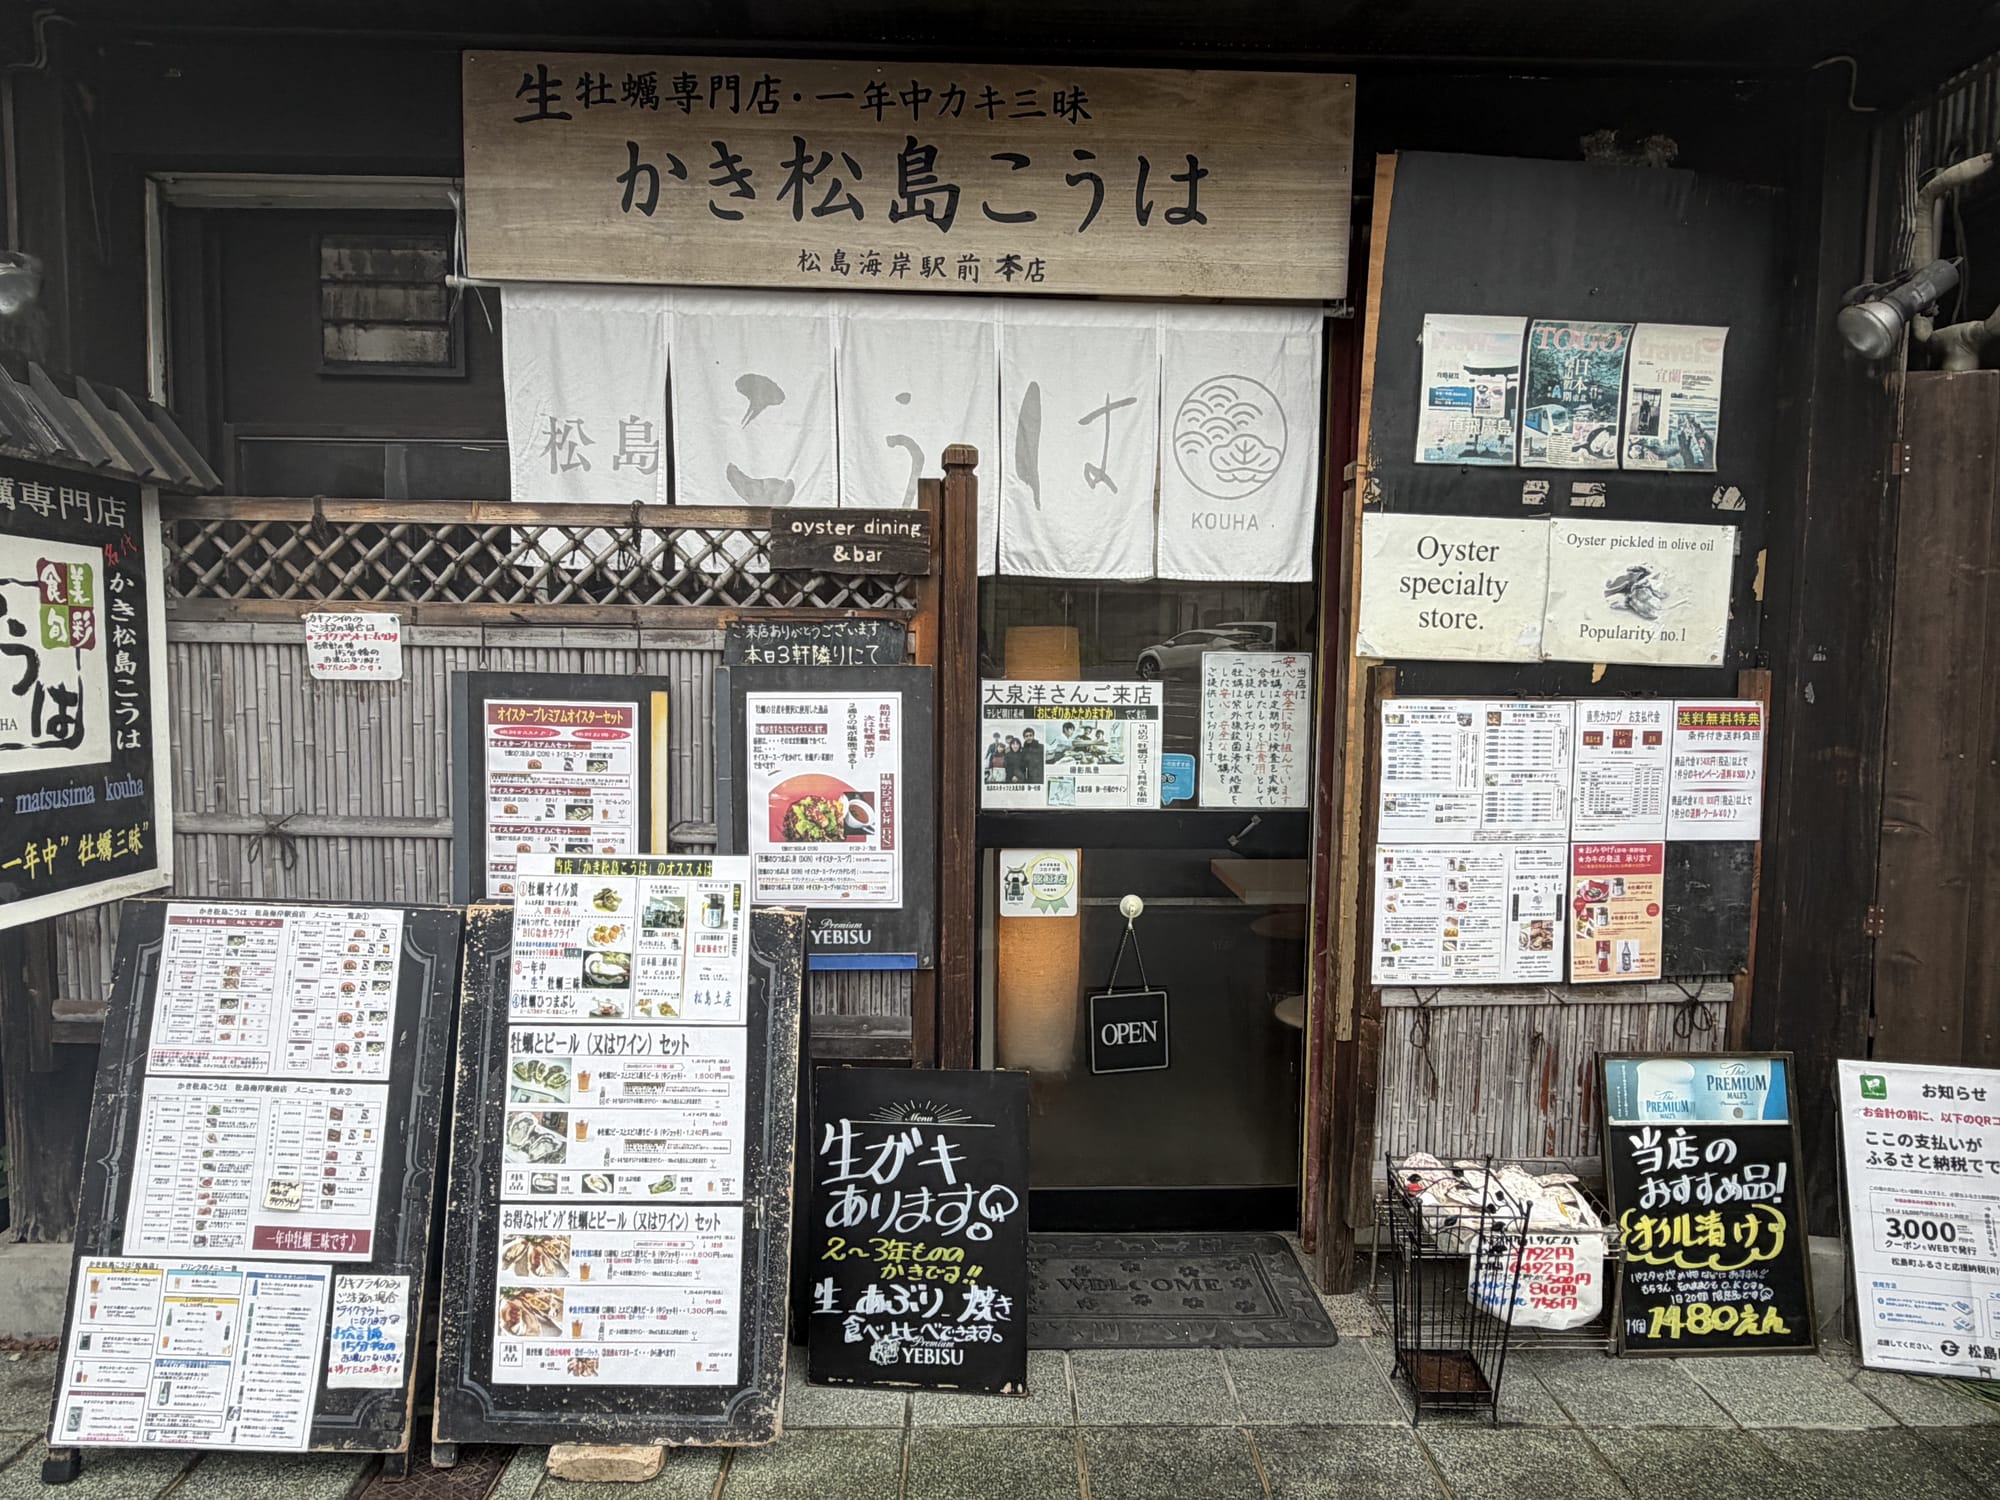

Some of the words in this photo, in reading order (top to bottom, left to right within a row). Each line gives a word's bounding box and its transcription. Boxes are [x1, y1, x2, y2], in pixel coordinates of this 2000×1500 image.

[617, 134, 1208, 235] かき松島こうは
[797, 249, 1047, 283] 松島海岸駅前本店
[540, 414, 660, 475] 松島
[791, 519, 856, 537] oyster
[864, 518, 922, 538] dining
[1191, 512, 1260, 532] KOUHA
[1416, 536, 1500, 567] Oyster
[1567, 533, 1607, 550] Oyster
[1610, 534, 1655, 553] pickled
[1658, 537, 1668, 549] in
[1671, 538, 1696, 551] olive
[1700, 538, 1714, 552] oil
[833, 545, 882, 563] &bar
[1399, 571, 1509, 604] specialty
[732, 621, 881, 640] ご来店ありがとうございます
[1418, 609, 1484, 631] store.
[1579, 624, 1656, 644] Popularity
[1660, 627, 1686, 642] no.1
[109, 572, 141, 750] かき松島こうは
[1295, 667, 1307, 700] 当店は
[984, 684, 1153, 705] 大泉洋さんご来店
[497, 706, 624, 725] オイスタープレミアムオイスターセット
[1678, 712, 1760, 727] 送料無料特典
[15, 780, 96, 814] matsusima
[104, 772, 144, 801] kouha
[819, 918, 863, 930] Premium
[811, 929, 872, 945] YEBISU
[1101, 1021, 1158, 1046] OPEN
[1720, 1063, 1750, 1076] The
[1706, 1075, 1768, 1092] PREMIUM
[1922, 1084, 1987, 1101] お知らせ
[1646, 1100, 1689, 1113] PREMIUM
[905, 1113, 933, 1123] Menu
[820, 1118, 968, 1186] 生ガキ
[1629, 1127, 1738, 1175] 当店の
[1865, 1131, 1983, 1153] ここの支払いが
[1630, 1210, 1762, 1249] オイル漬け
[1885, 1217, 1956, 1242] 3,000
[1056, 1277, 1224, 1293] WELCOME
[811, 1277, 843, 1314] 生
[957, 1284, 1014, 1322] 焼き
[1648, 1302, 1791, 1339] 1480えん
[902, 1348, 965, 1366] YEBISU
